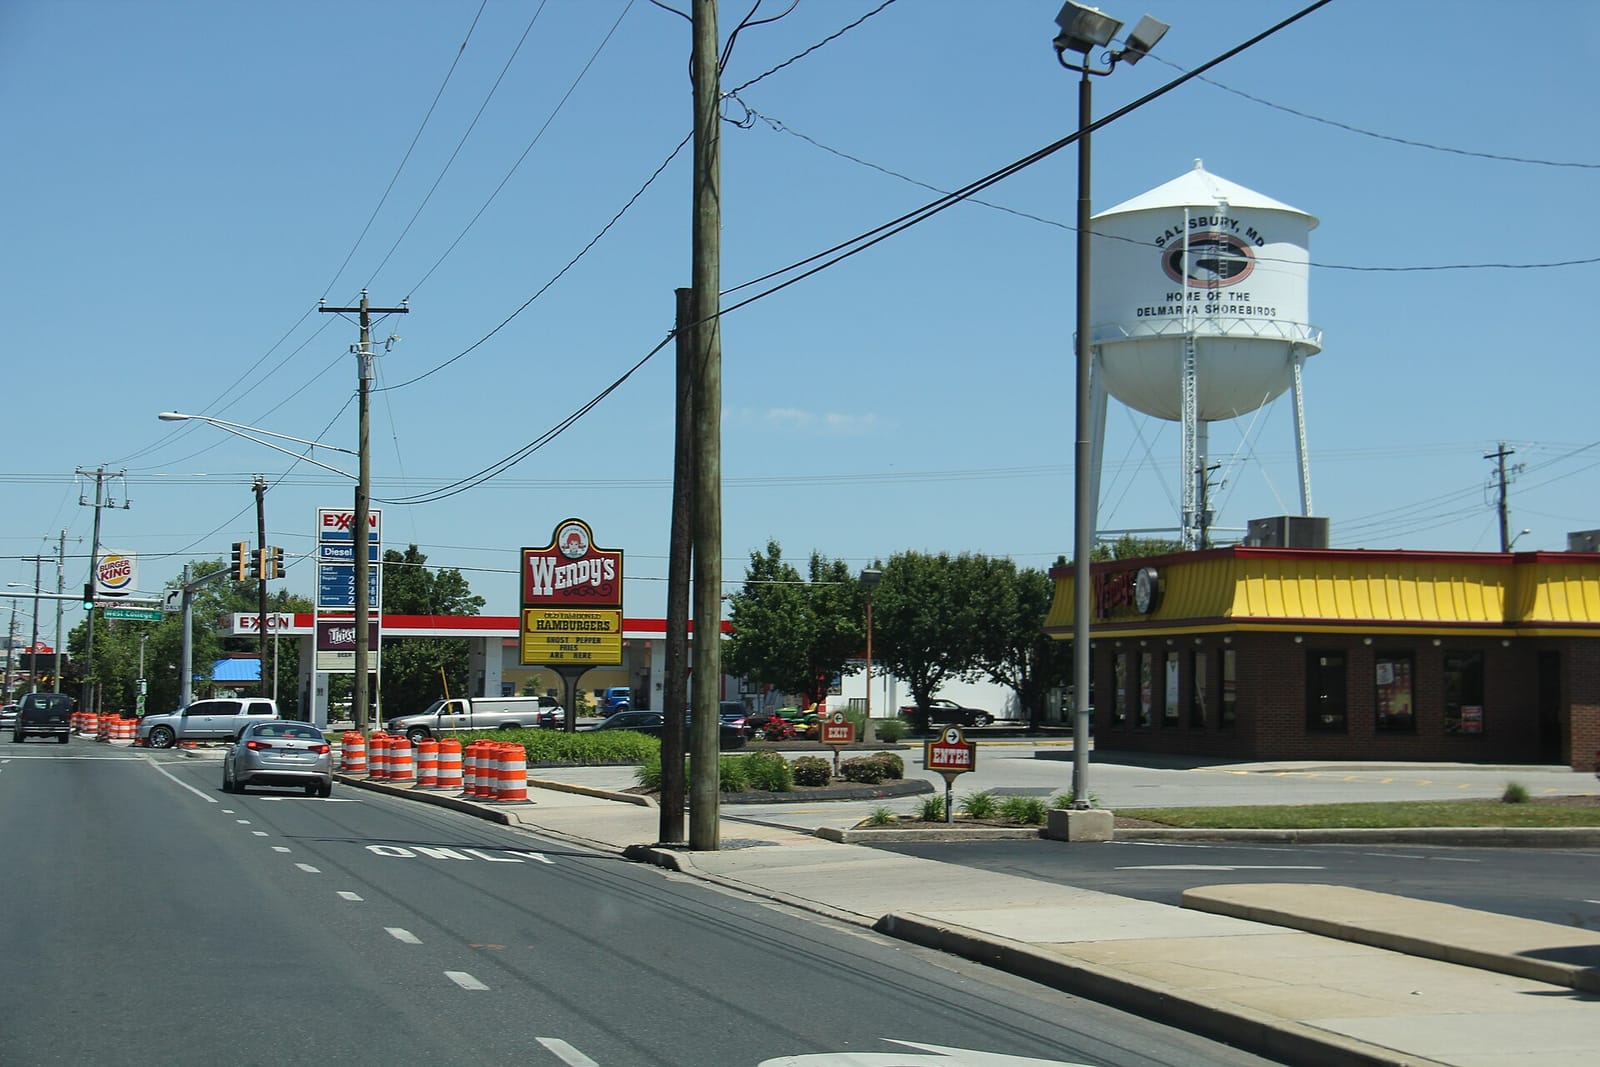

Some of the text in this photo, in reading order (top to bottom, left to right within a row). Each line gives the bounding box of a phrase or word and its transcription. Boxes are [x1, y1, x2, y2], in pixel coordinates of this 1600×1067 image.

[1245, 226, 1265, 248] MD
[1207, 292, 1222, 301] OF
[1229, 292, 1250, 301] THE
[1205, 304, 1276, 316] SHOREBIRDS
[323, 512, 377, 531] EXXN
[324, 547, 353, 556] Diesel
[99, 559, 130, 573] BURGER
[100, 566, 131, 581] KING
[536, 620, 610, 631] HAMBURGERS
[828, 727, 849, 739] EXIT
[932, 747, 970, 765] ENTER
[365, 844, 555, 864] ONLY
